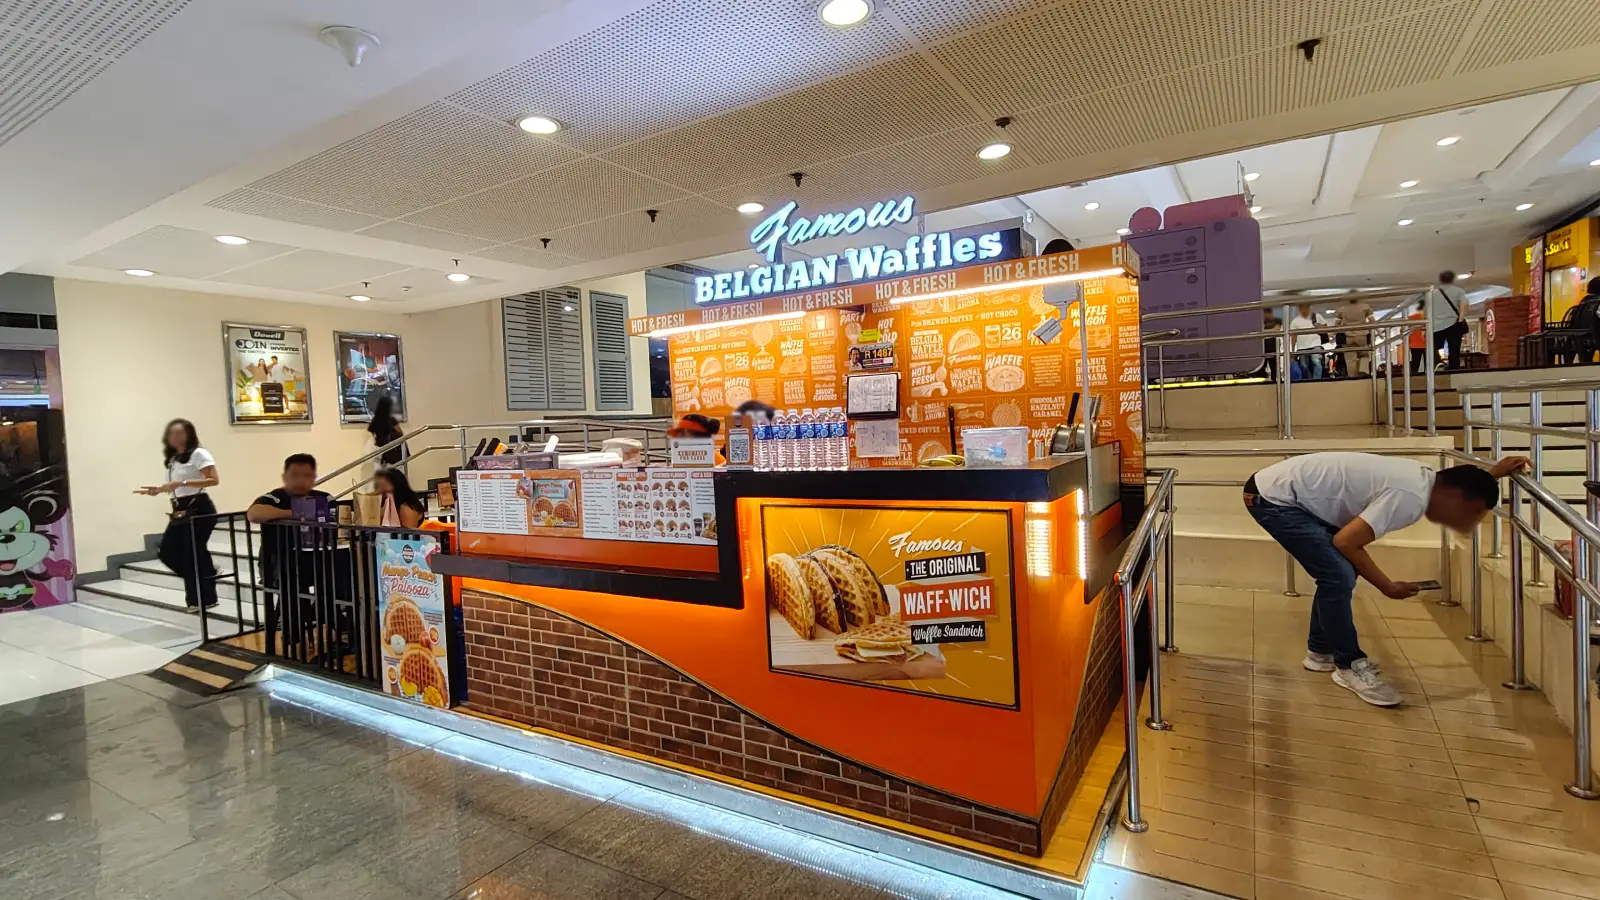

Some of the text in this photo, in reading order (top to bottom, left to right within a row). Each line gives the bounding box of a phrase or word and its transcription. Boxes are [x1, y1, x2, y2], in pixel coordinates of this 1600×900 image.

[751, 196, 914, 262] Famous
[695, 231, 1002, 302] BELGIAN Waffles
[983, 253, 1080, 284] HOT & FRESH
[875, 272, 957, 300] HOT & FRESH
[782, 295, 804, 313] HOT
[805, 294, 814, 310] &
[814, 288, 853, 308] FRESH
[702, 301, 763, 323] HOT & FRESH
[949, 314, 974, 323] COFFEE
[980, 311, 995, 320] HOT
[631, 313, 685, 334] HOT & FRESH
[878, 317, 894, 330] HOT
[910, 334, 943, 345] BELGIAN
[1001, 327, 1022, 341] 26
[780, 339, 805, 350] WAFFLE
[911, 344, 944, 355] WAFFLE
[781, 348, 803, 357] WAGON
[873, 347, 893, 359] 1487
[735, 355, 750, 368] 26
[948, 354, 981, 366] Famous
[985, 354, 1023, 371] WAFFIE
[911, 365, 932, 378] HOT &
[724, 377, 751, 391] WAFFIE
[912, 374, 935, 387] FRESH
[888, 531, 963, 558] Famous
[910, 554, 981, 578] THE ORIGINAL
[391, 578, 430, 596] Palooza
[913, 622, 984, 643] Waffle Sandwich
